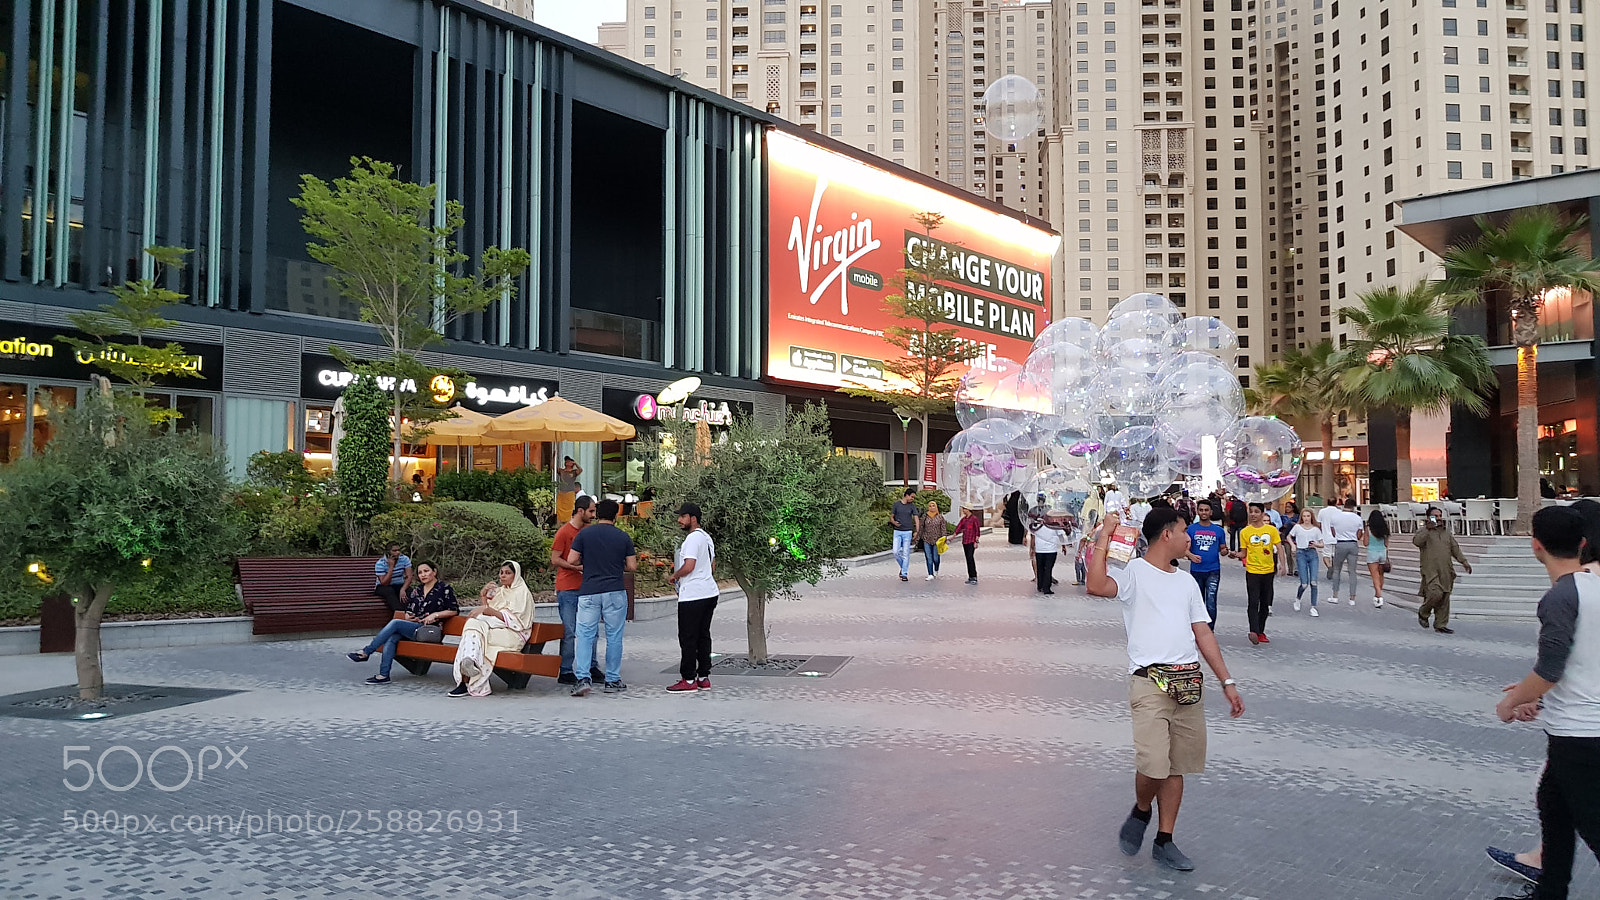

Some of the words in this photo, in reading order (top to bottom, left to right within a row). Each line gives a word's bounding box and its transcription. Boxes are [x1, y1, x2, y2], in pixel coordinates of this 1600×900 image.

[787, 176, 881, 316] Virgin
[906, 236, 991, 287] CHANGE
[994, 262, 1043, 301] YOUR
[853, 273, 879, 288] mobile
[907, 280, 985, 327] MOBILE
[988, 302, 1035, 338] PLAN
